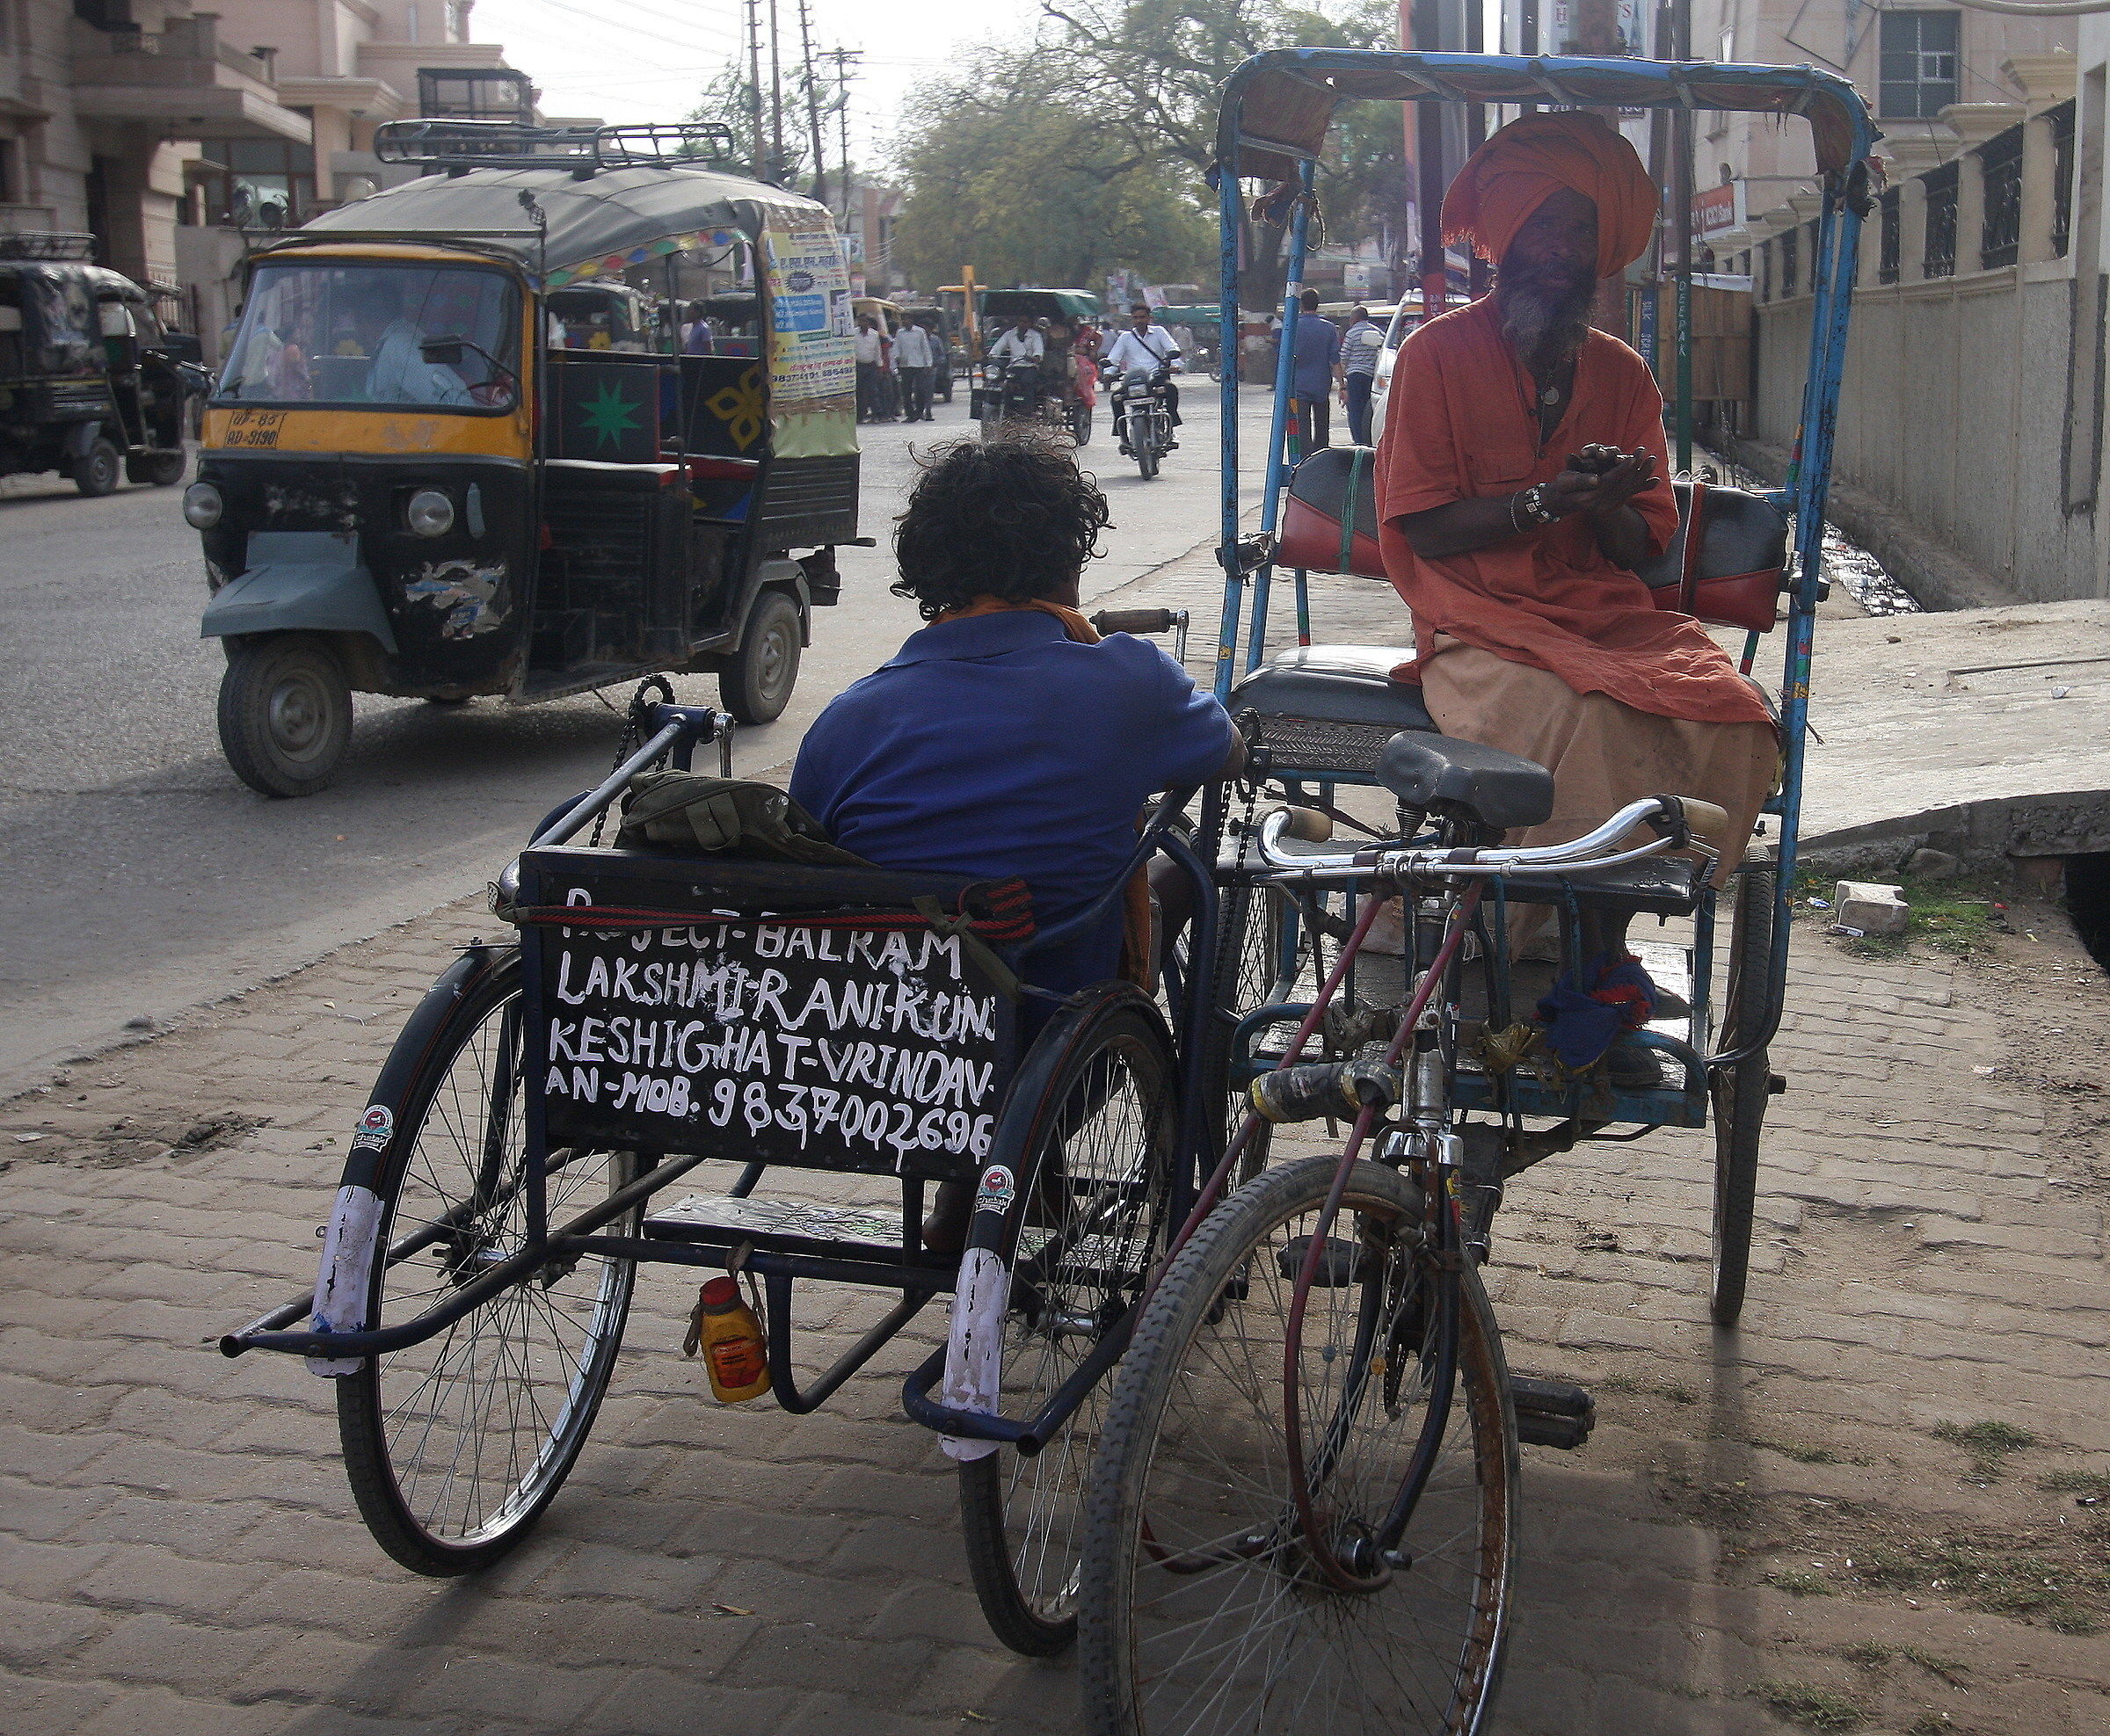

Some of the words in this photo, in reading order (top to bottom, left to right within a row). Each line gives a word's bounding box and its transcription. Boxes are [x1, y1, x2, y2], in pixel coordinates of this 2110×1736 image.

[1678, 280, 1687, 357] DEEPAK
[563, 888, 961, 980] PJECT-BALRAM
[708, 1078, 993, 1162] 9837002696
